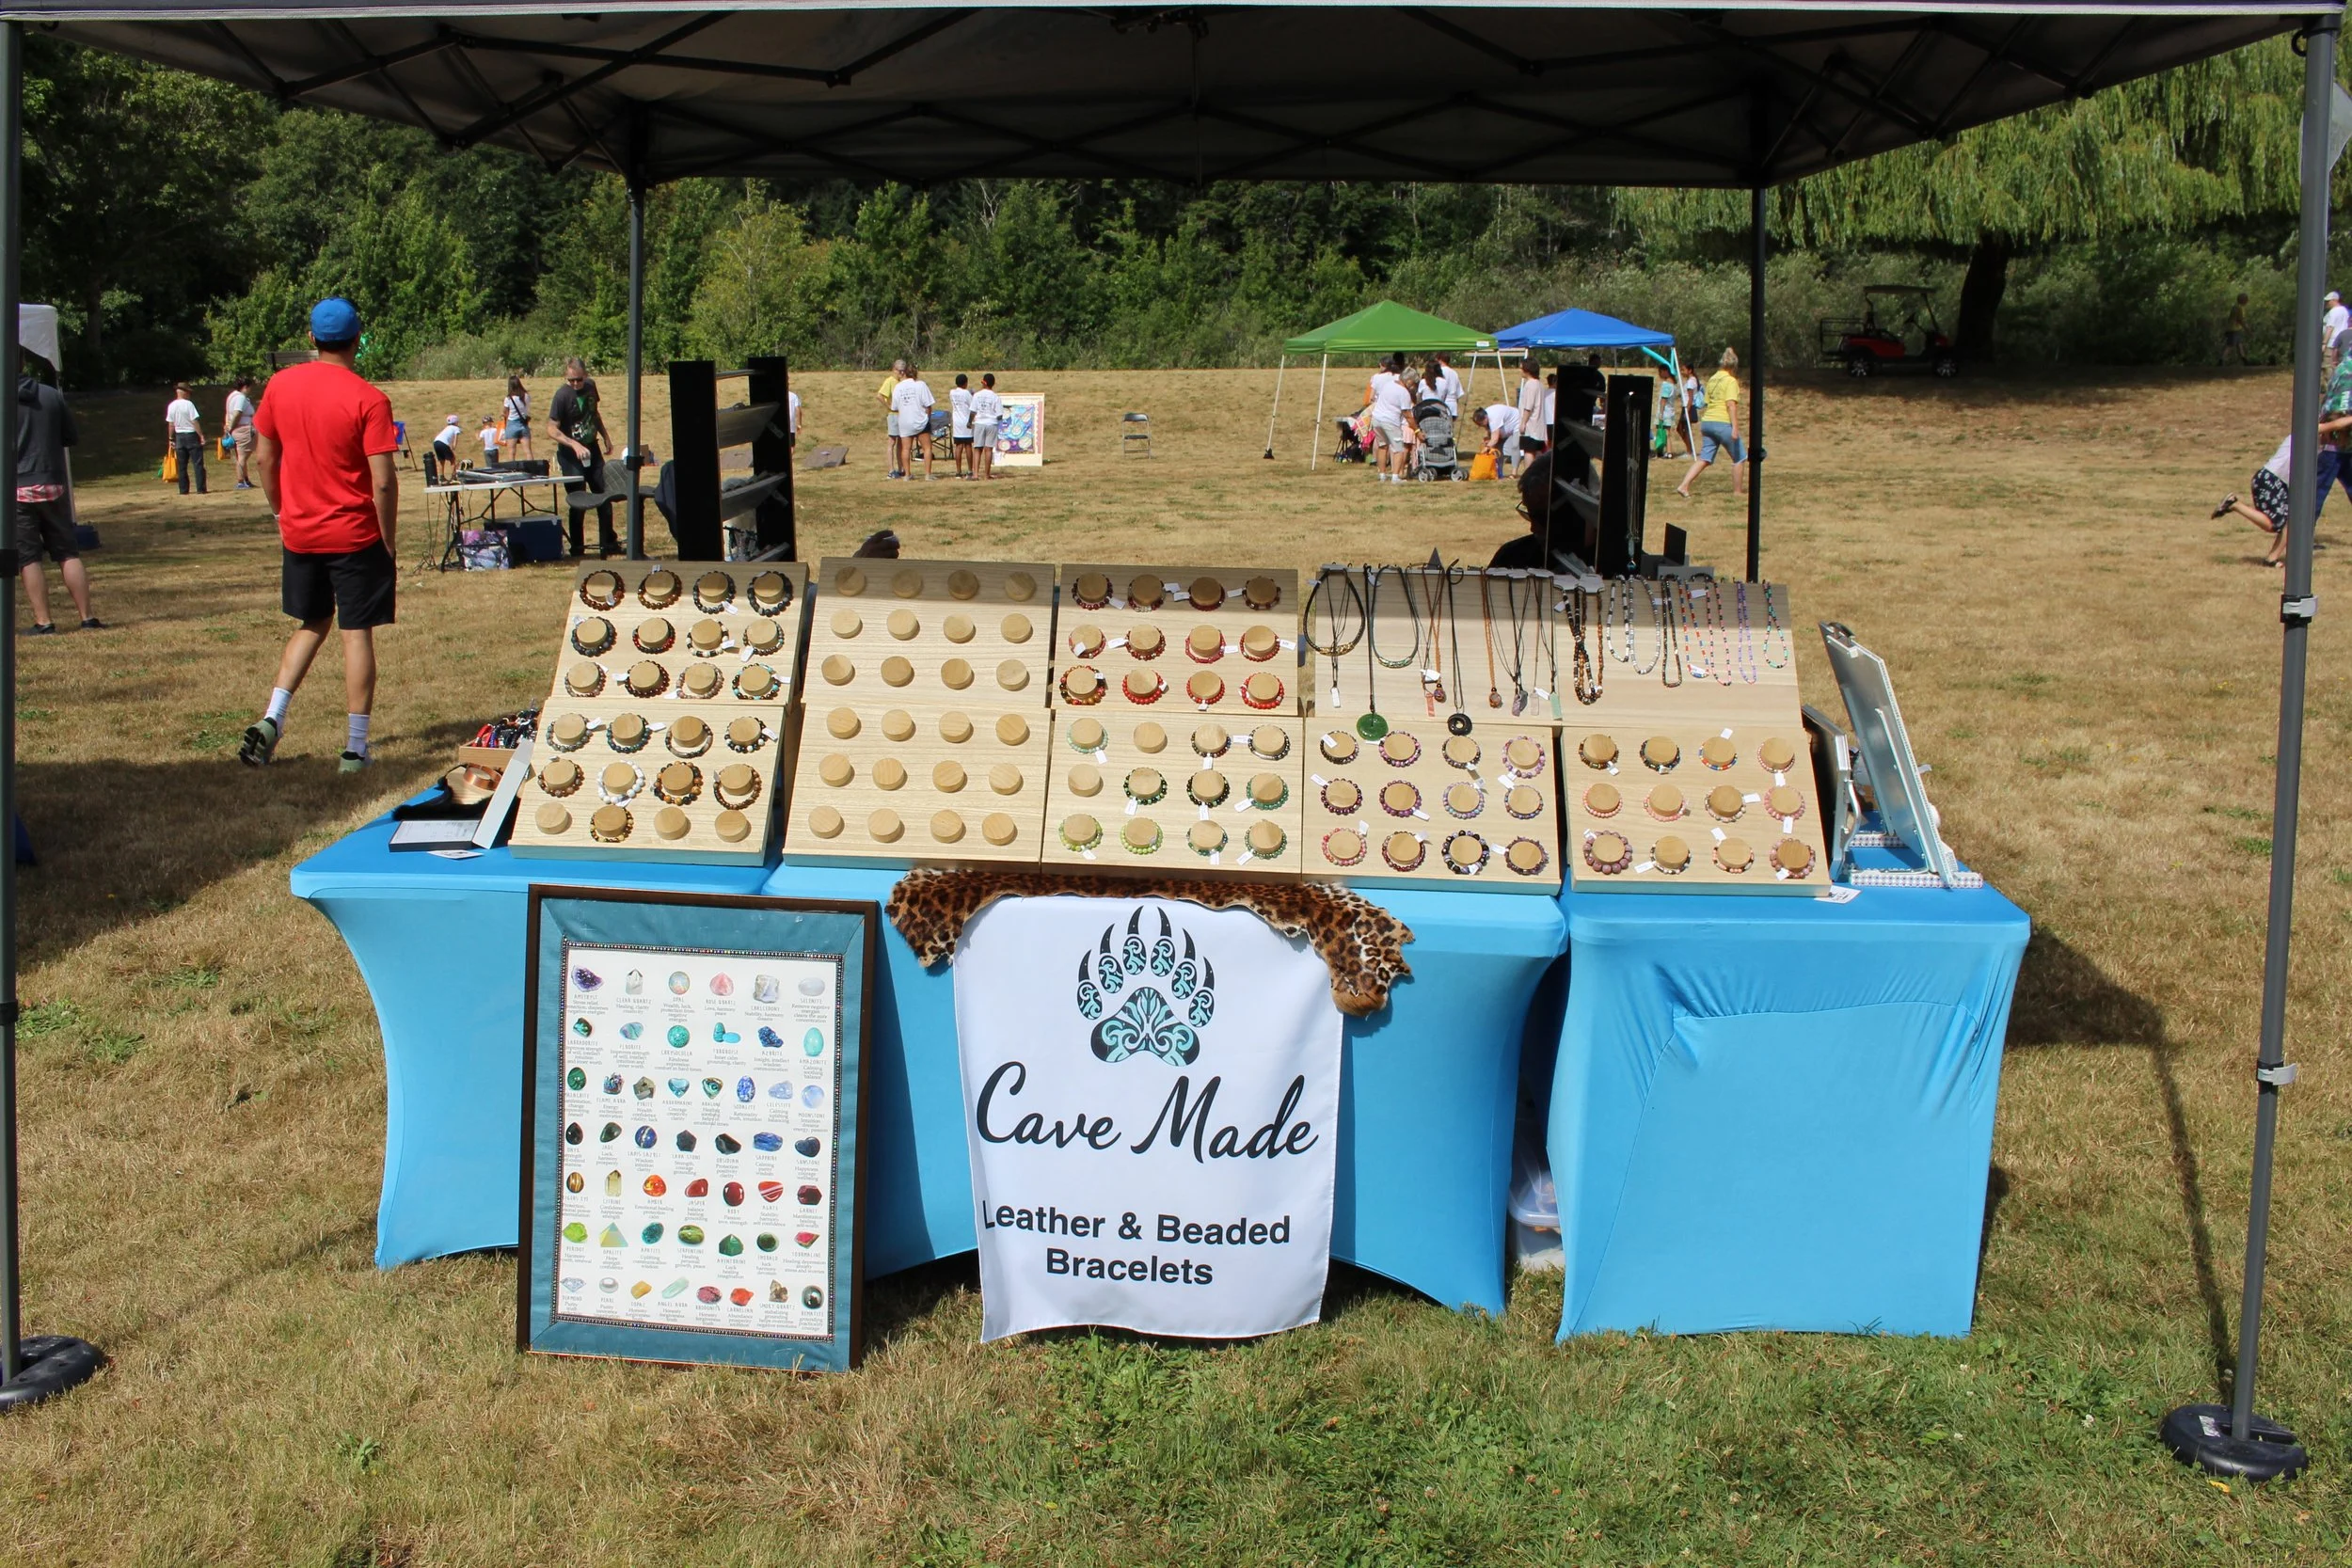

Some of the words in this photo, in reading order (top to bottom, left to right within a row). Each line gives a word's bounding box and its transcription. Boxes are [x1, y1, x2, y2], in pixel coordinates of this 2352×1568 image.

[976, 1061, 1122, 1150] Cave
[1130, 1074, 1319, 1164] Made
[982, 1199, 1105, 1238] Leather
[1118, 1212, 1143, 1240] &
[1157, 1214, 1290, 1245] Beaded
[1046, 1247, 1214, 1285] Bracelets
